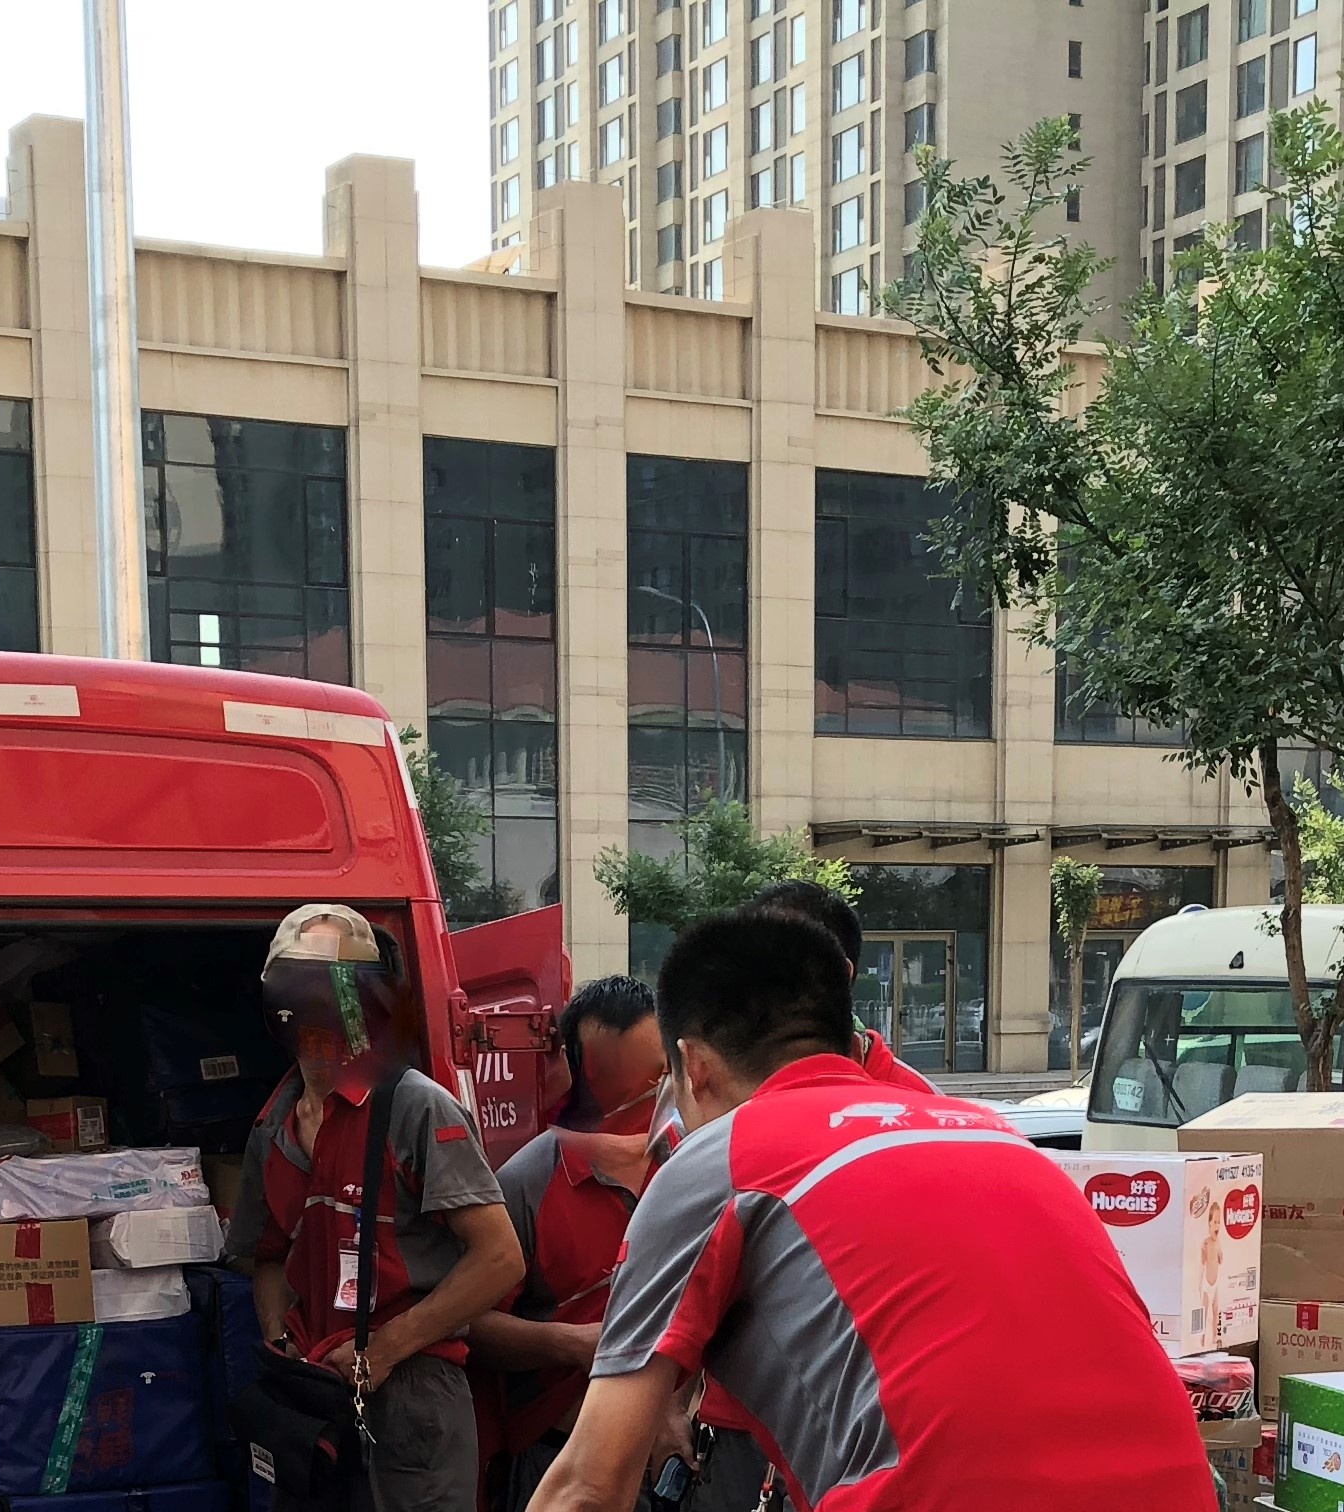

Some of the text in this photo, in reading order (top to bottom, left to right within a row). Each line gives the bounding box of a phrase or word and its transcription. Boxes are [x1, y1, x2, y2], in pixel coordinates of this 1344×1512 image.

[481, 1096, 518, 1130] stics
[1130, 1178, 1157, 1196] 好奇
[1091, 1191, 1158, 1212] HUGGIES
[1276, 1331, 1344, 1351] JD.COM 京东
